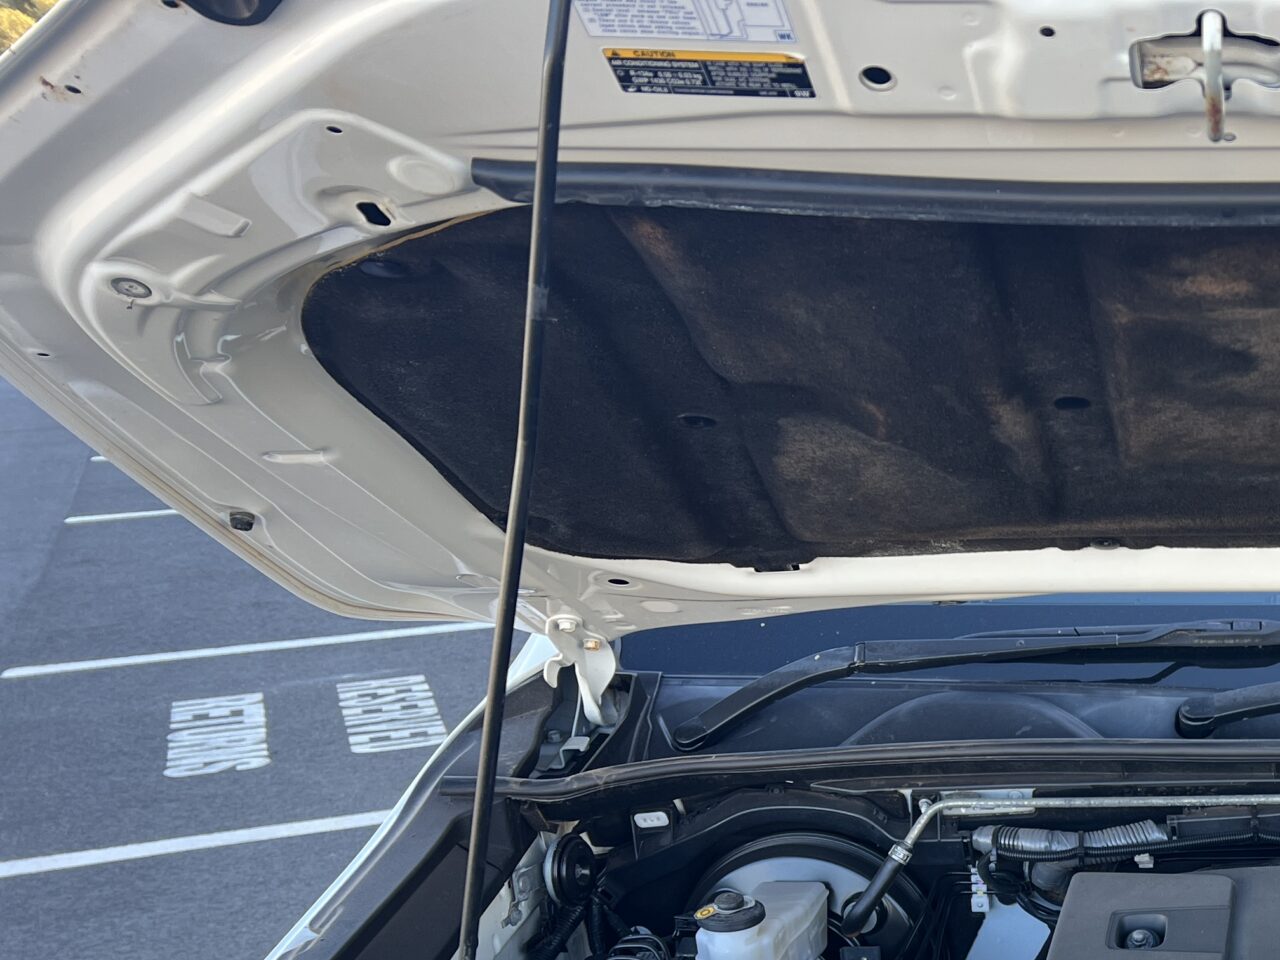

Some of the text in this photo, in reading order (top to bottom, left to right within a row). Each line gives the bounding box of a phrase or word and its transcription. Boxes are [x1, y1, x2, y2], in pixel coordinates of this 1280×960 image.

[632, 50, 676, 59] CAUTION
[163, 692, 272, 778] RETURNS
[335, 674, 447, 754] RESERVED
